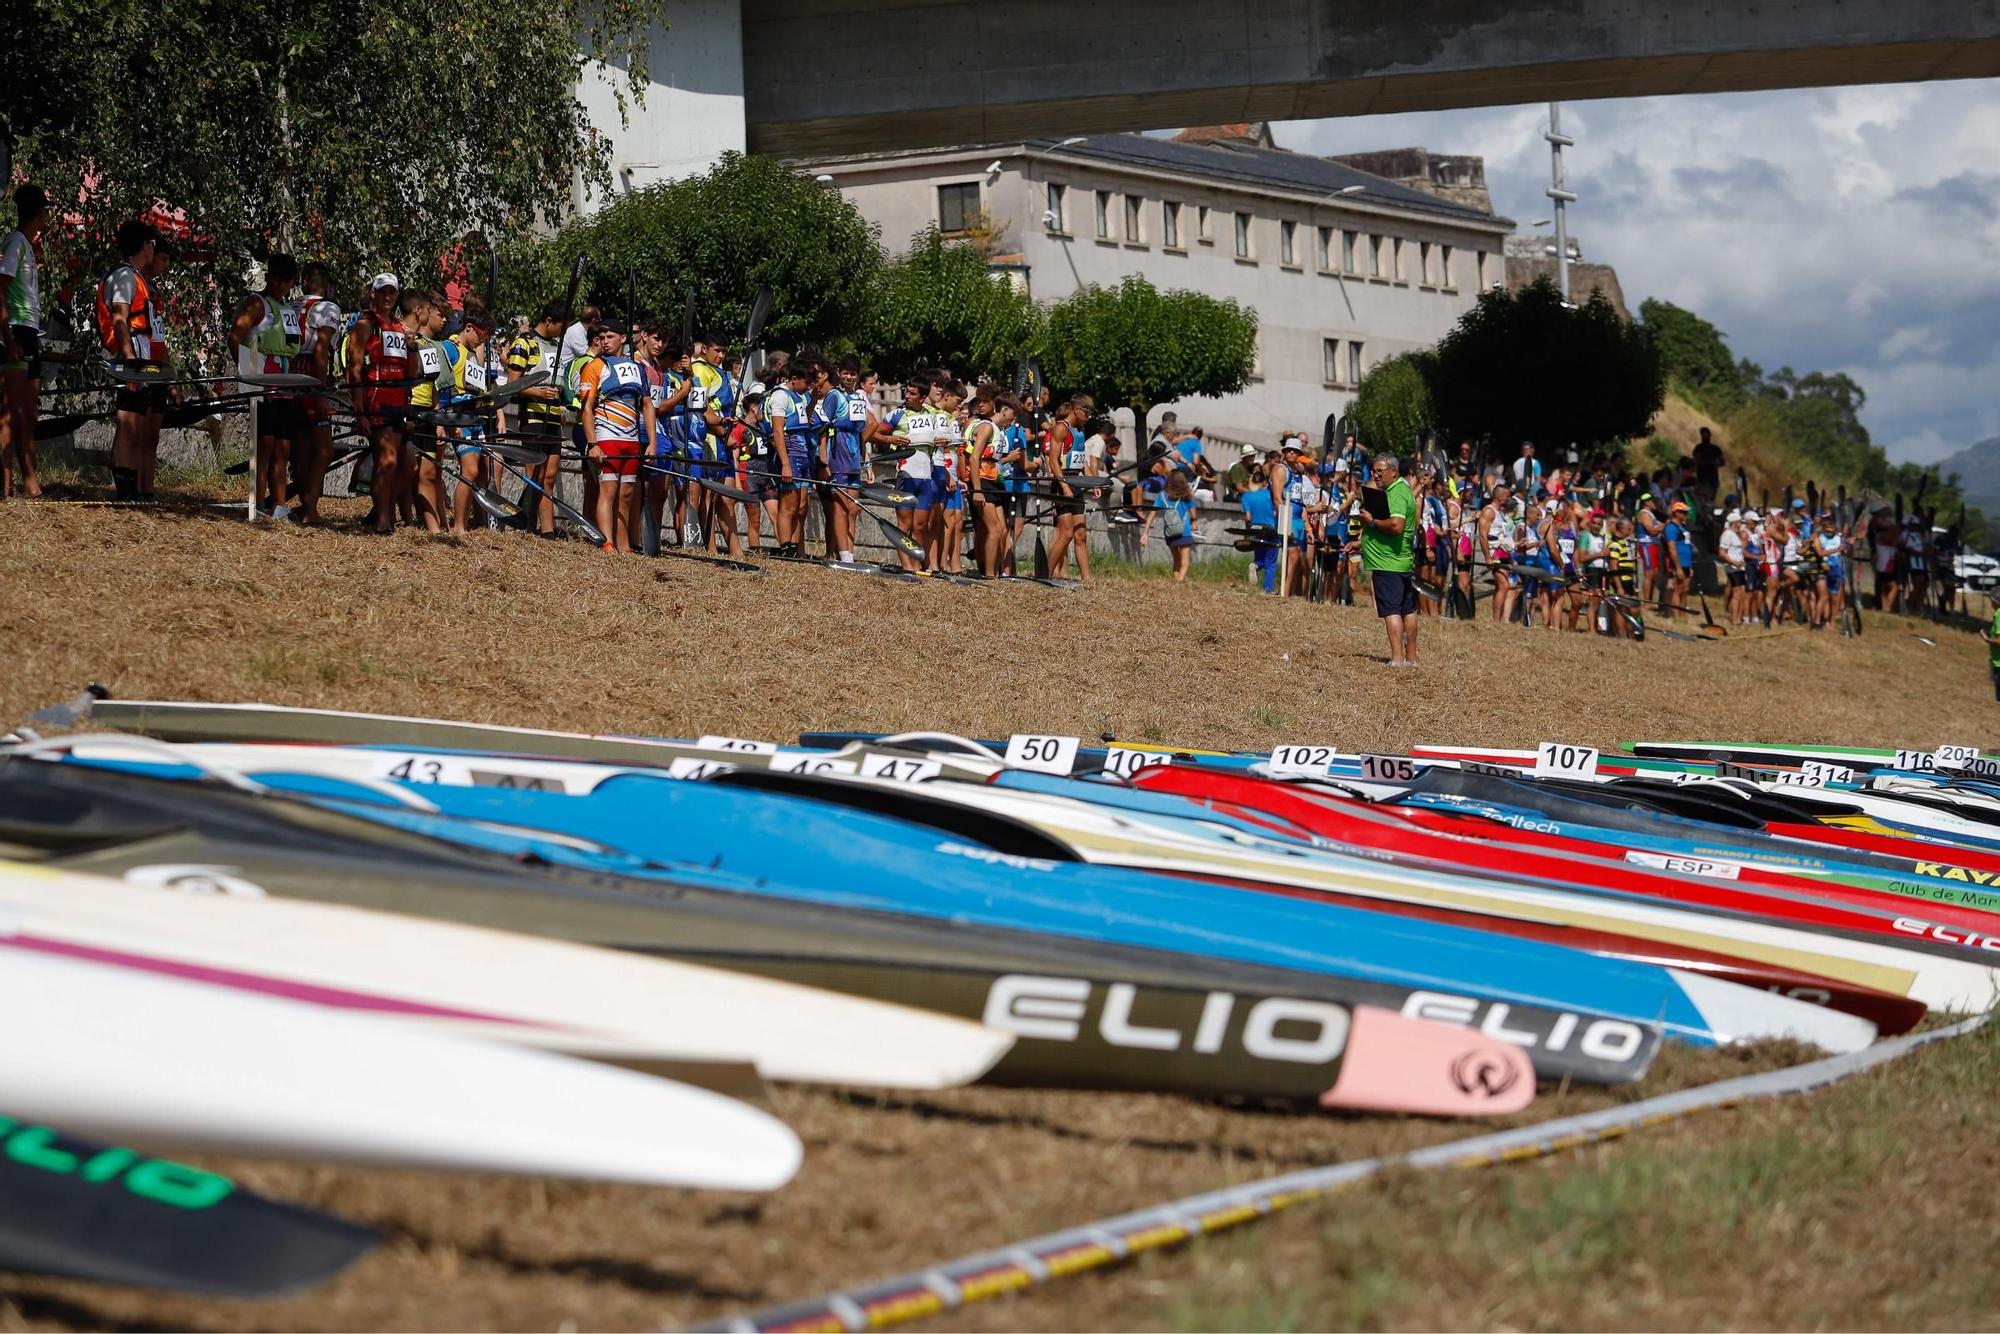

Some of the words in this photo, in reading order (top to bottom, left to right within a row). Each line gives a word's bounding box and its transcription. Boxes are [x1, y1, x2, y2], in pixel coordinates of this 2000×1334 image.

[467, 364, 484, 381] 207
[619, 366, 639, 377] 211
[911, 418, 931, 429] 224
[1021, 738, 1060, 762] 50
[1279, 747, 1330, 766] 102
[1546, 745, 1592, 770] 107
[1942, 747, 1974, 761] 201
[1364, 756, 1414, 781] 105
[1898, 751, 1934, 770] 116
[1963, 757, 1998, 775] 200
[876, 760, 924, 782] 47
[1665, 858, 1713, 873] ESP
[1887, 880, 1926, 897] Club
[1932, 887, 1954, 901] de
[1960, 891, 1998, 907] Mar
[983, 973, 1351, 1065] ELIO
[1401, 990, 1644, 1063] ELIO
